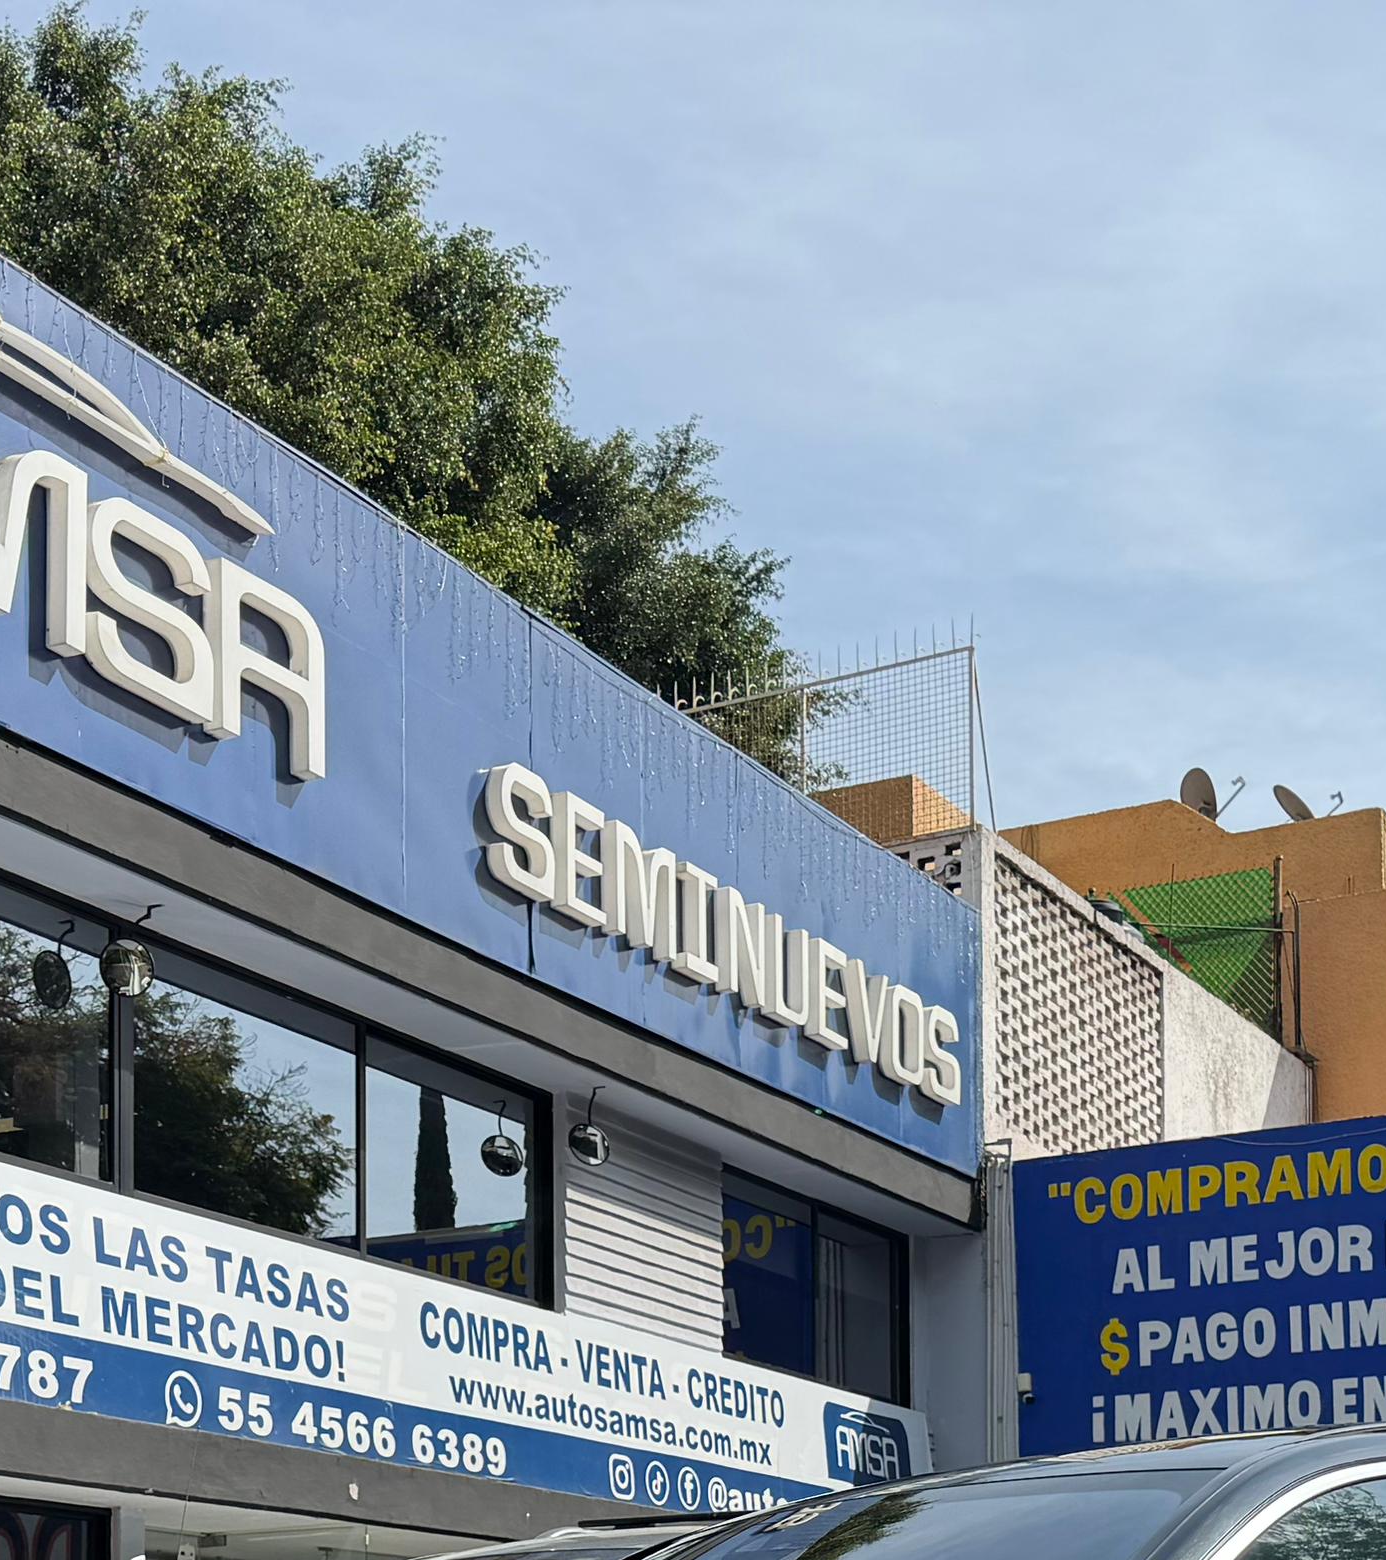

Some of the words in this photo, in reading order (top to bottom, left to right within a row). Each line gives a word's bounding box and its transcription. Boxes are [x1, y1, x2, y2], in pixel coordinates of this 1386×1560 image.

[485, 762, 961, 1105] SEMINUEVOS
[93, 1216, 189, 1283] LAS
[205, 1246, 350, 1322] TASAS
[1112, 1245, 1175, 1294] AL
[1189, 1224, 1373, 1287] MEJOR
[101, 1286, 345, 1382] MERCADO!
[420, 1301, 553, 1374] COMPRA
[575, 1339, 666, 1400] VENTA
[687, 1368, 785, 1428] CREDITO
[217, 1386, 273, 1437] 55
[291, 1401, 396, 1458] 4566
[412, 1424, 507, 1476] 6389
[449, 1375, 772, 1466] www.autosamsa.com.mx
[835, 1424, 900, 1479] AMSA
